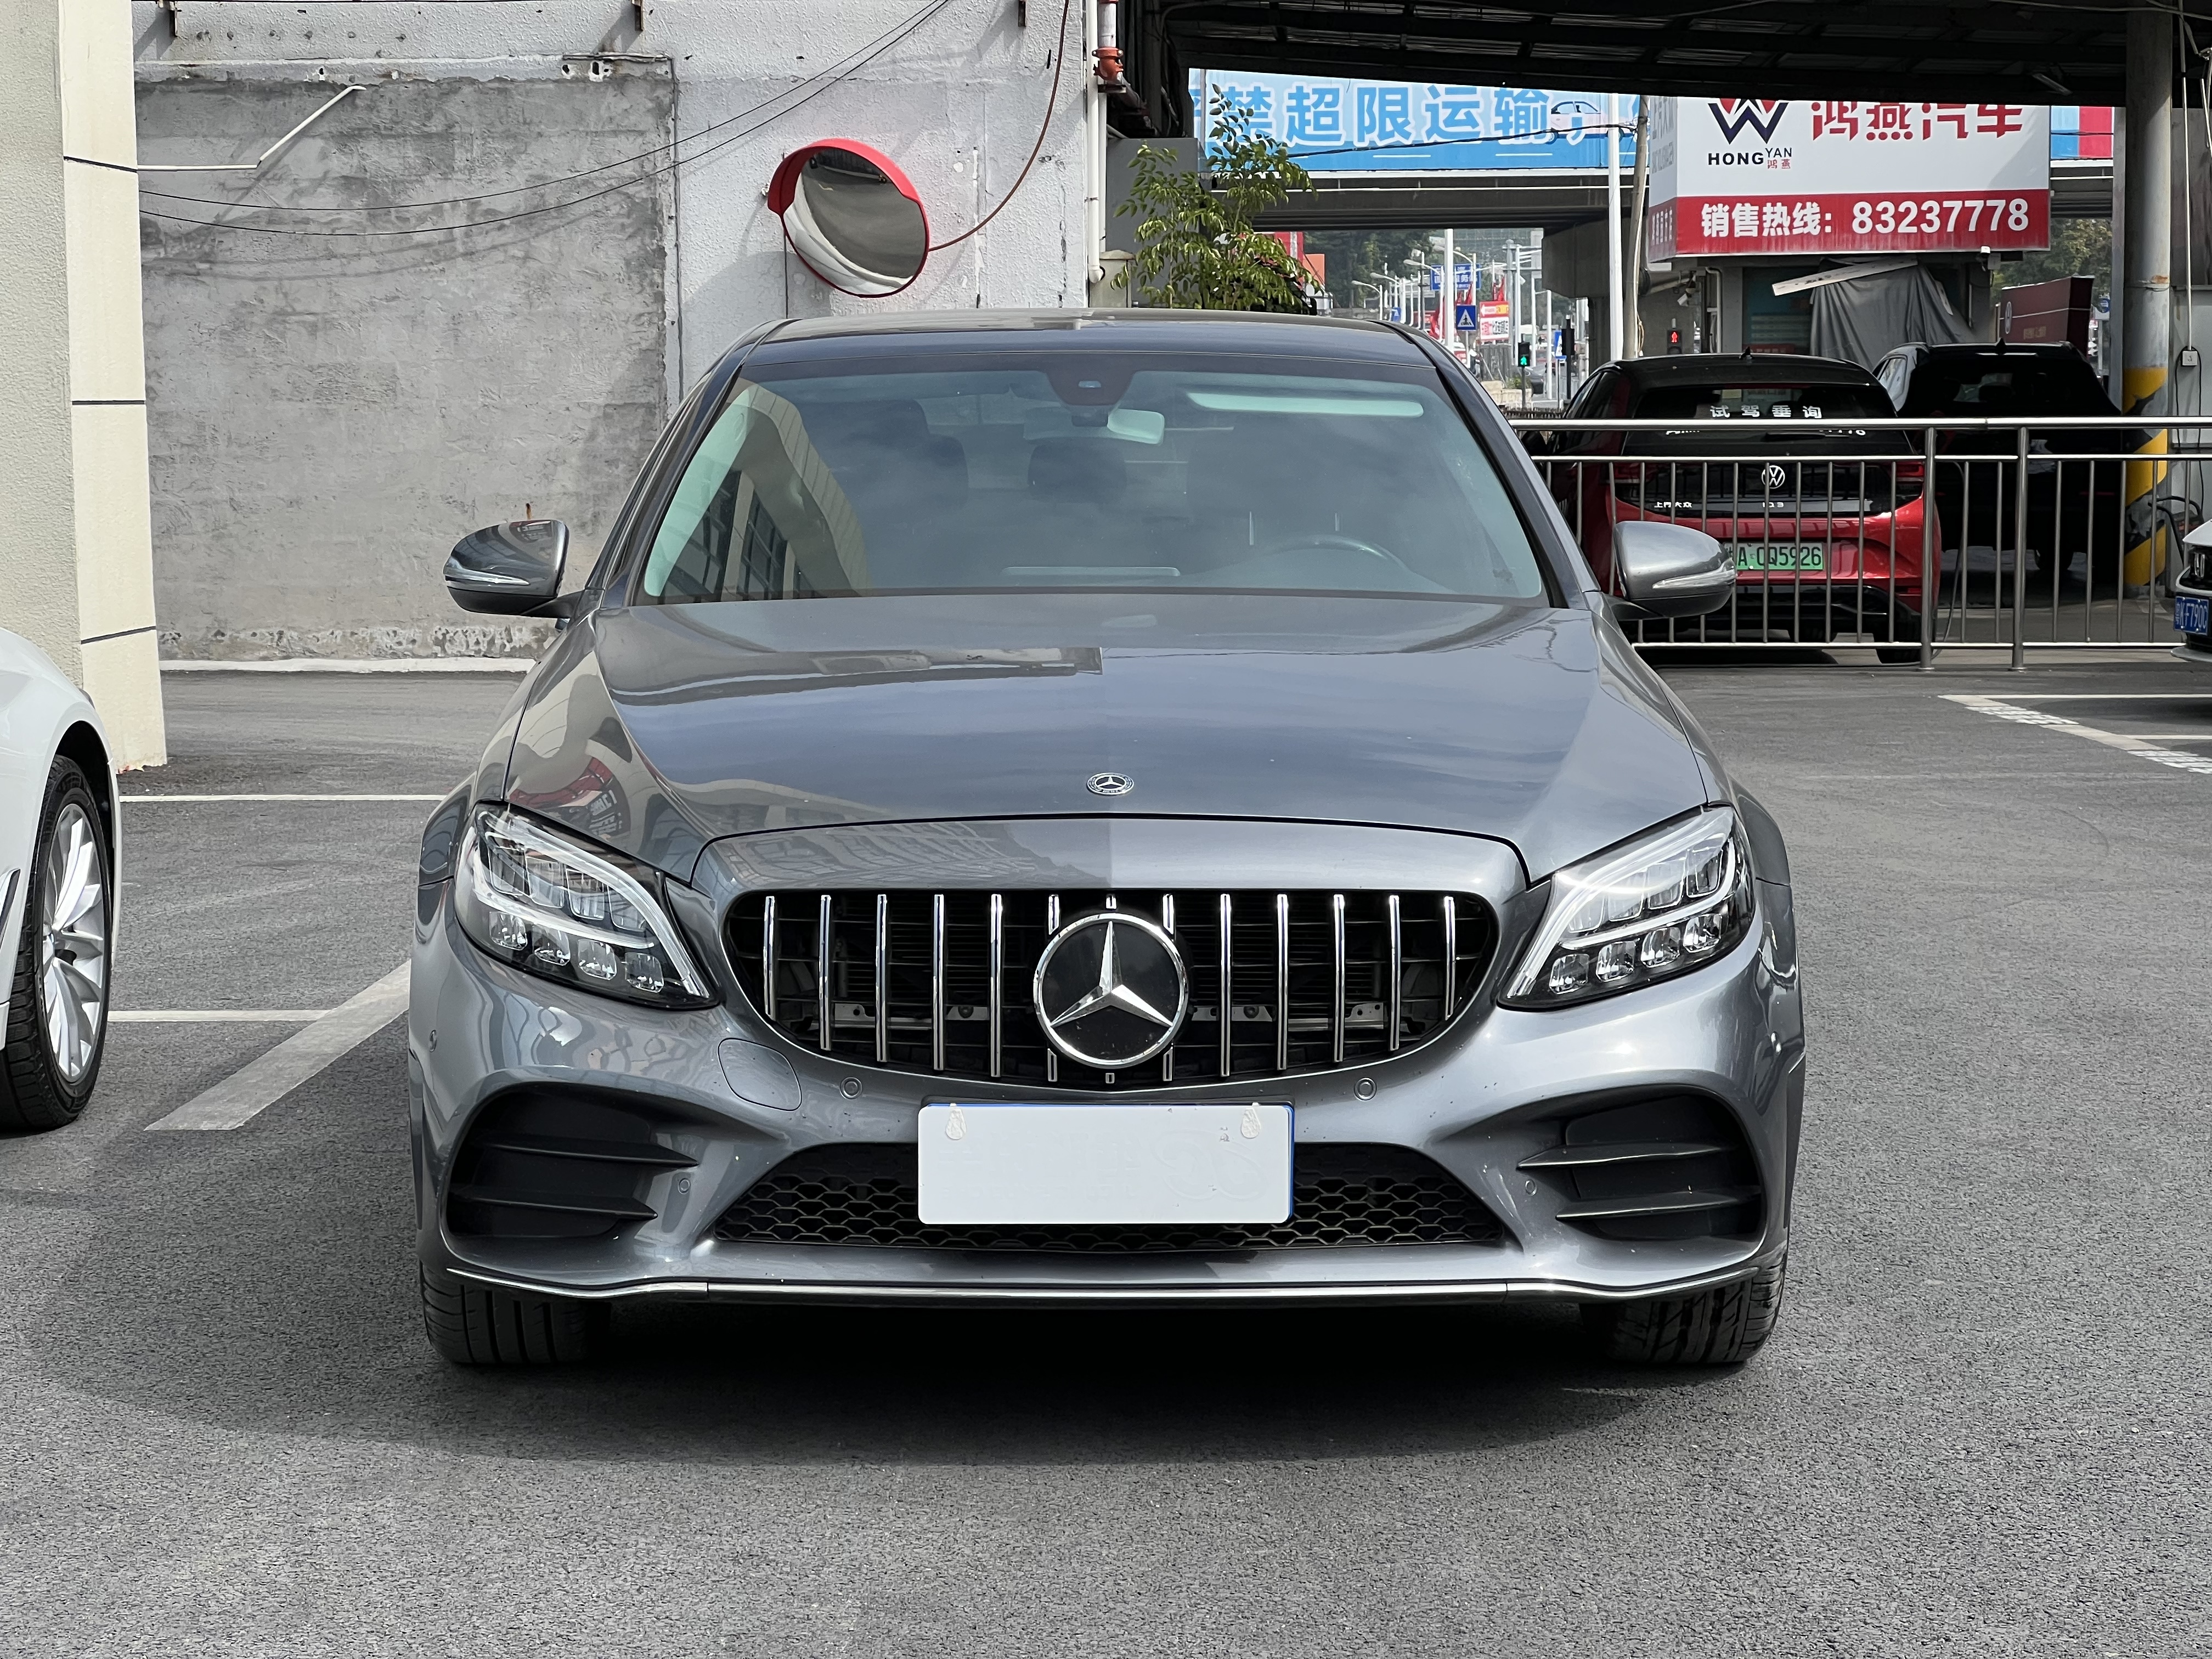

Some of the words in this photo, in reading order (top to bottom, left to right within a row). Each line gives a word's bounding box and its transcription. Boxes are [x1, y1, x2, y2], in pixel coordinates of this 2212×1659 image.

[1811, 101, 2023, 141] 鸿燕汽车
[1708, 153, 1764, 166] HONG
[1765, 147, 1792, 158] YAN
[1767, 159, 1791, 170] 鸿燕
[1701, 202, 1832, 238] 销售热线：
[1852, 198, 2029, 234] 83237778
[1710, 405, 1822, 419] 试驾垂询
